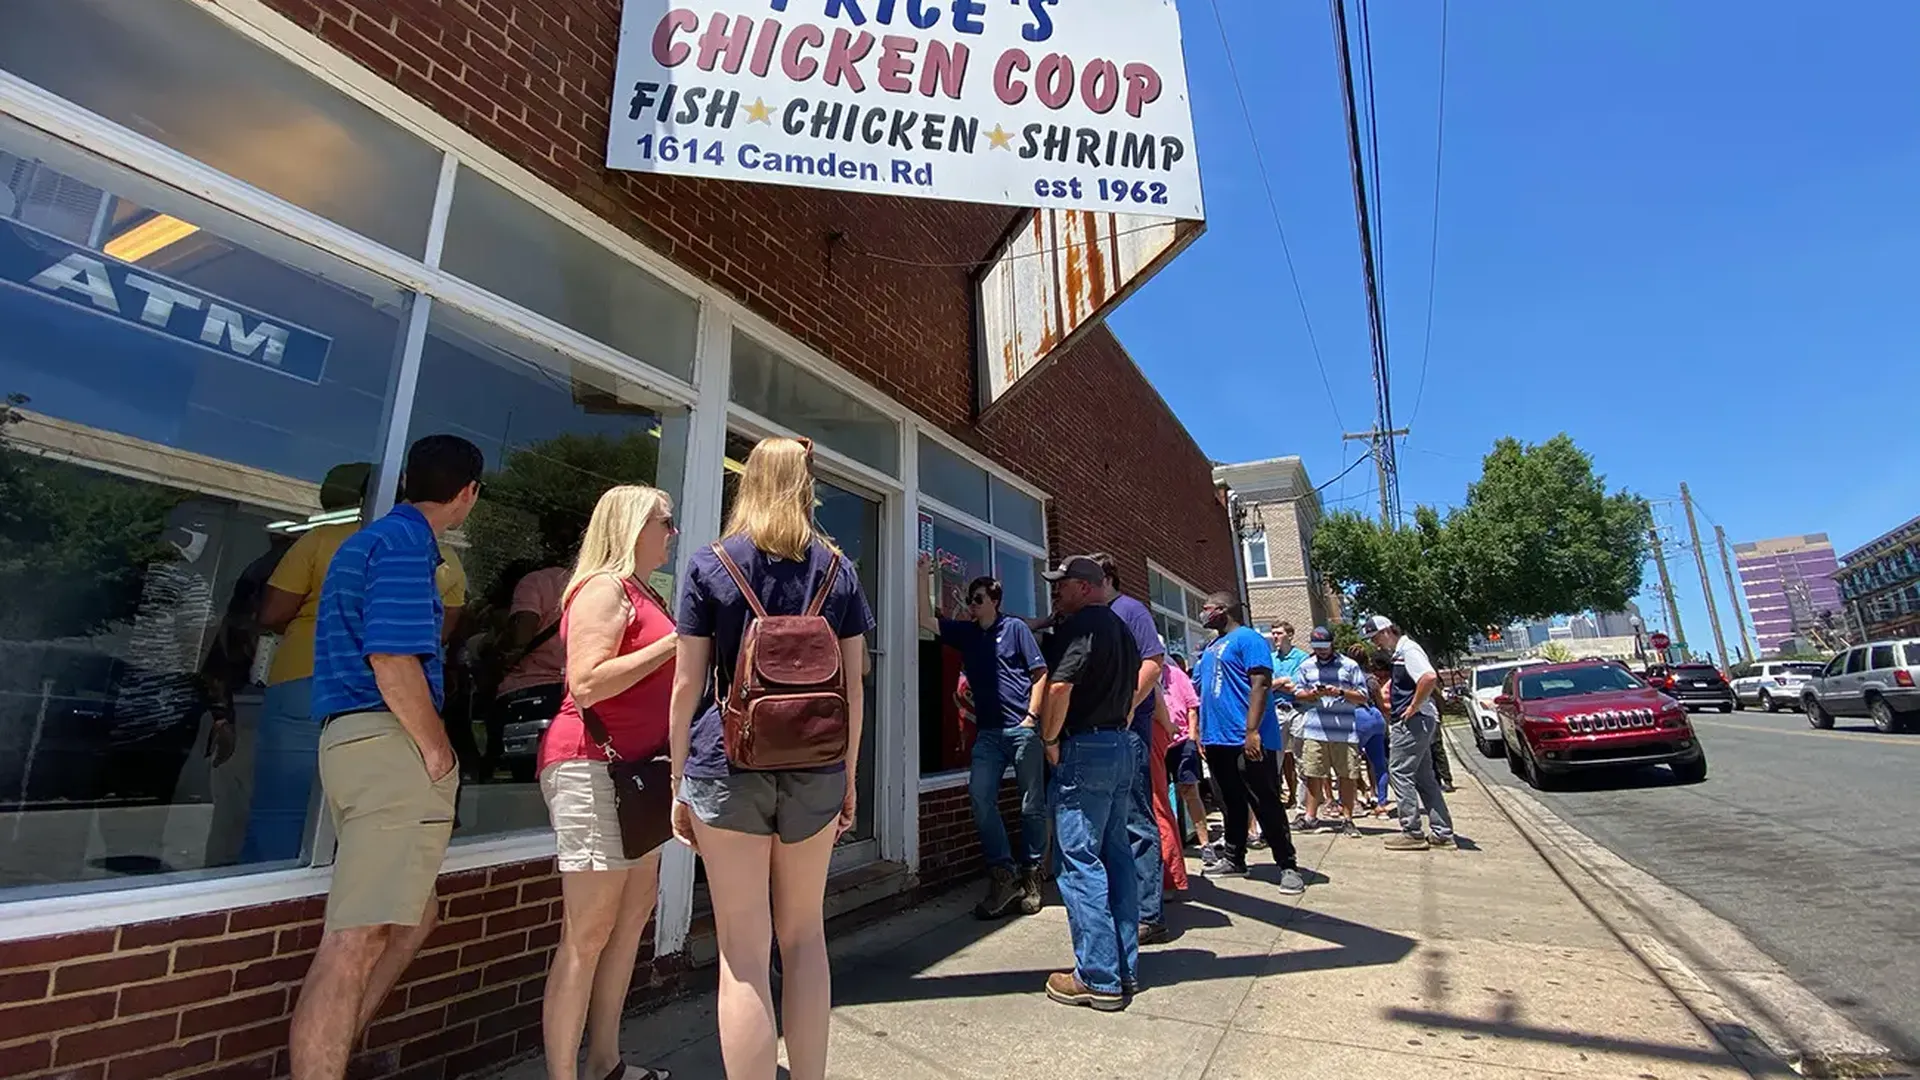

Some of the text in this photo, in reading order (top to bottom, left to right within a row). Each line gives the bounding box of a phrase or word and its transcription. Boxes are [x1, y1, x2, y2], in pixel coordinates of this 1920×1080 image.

[770, 0, 1058, 42] RICES
[652, 9, 1162, 118] CHICKEN COOP
[628, 82, 1184, 171] FISH CHICKEN SHRIMP
[637, 134, 933, 186] 1614 Camden Rd
[1034, 177, 1168, 205] est 1962
[28, 253, 290, 365] ATM
